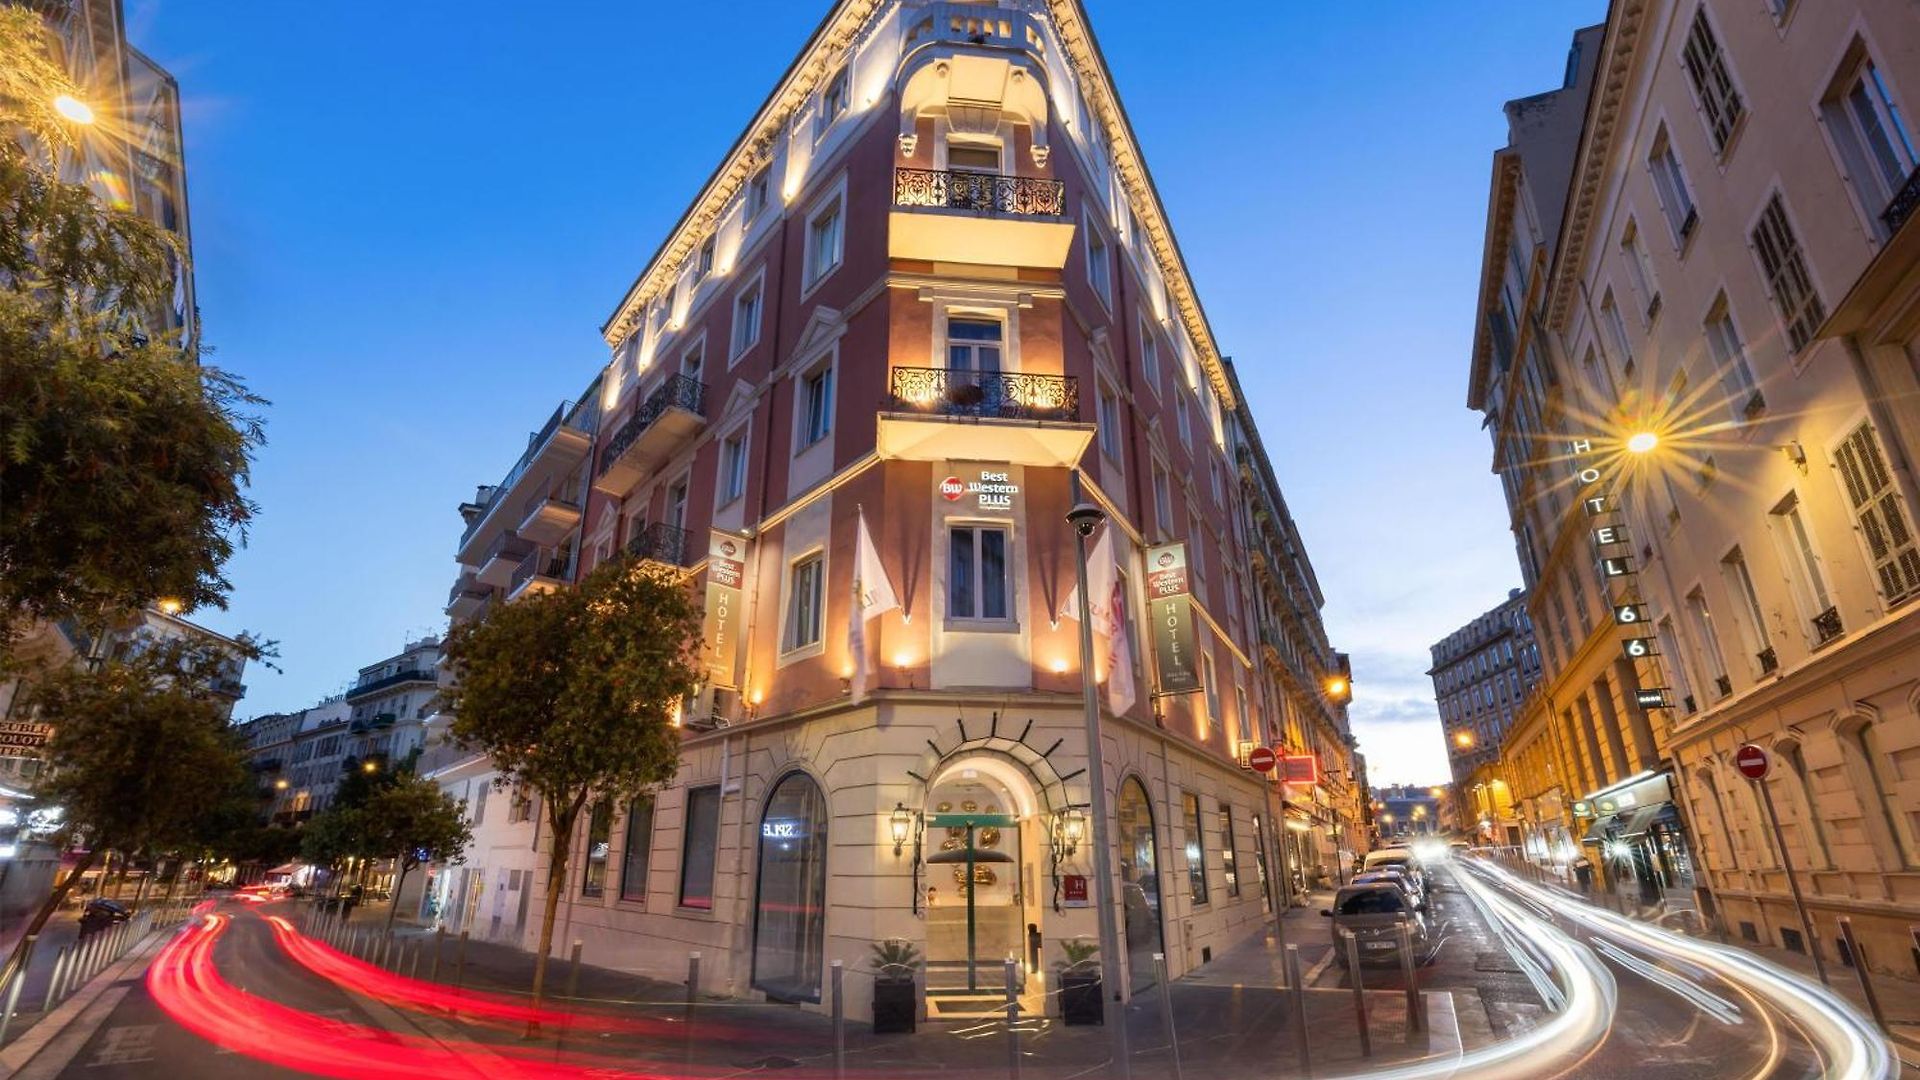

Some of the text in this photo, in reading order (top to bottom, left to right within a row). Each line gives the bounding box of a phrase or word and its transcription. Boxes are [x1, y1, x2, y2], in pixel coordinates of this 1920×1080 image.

[942, 483, 962, 493] BW
[969, 482, 1018, 493] Western
[981, 471, 1008, 481] Best
[979, 494, 1011, 505] PLUS
[1573, 438, 1623, 576] HOTEL
[716, 593, 729, 658] HOTEL
[1166, 603, 1182, 666] HOTEL
[1620, 606, 1646, 656] 66
